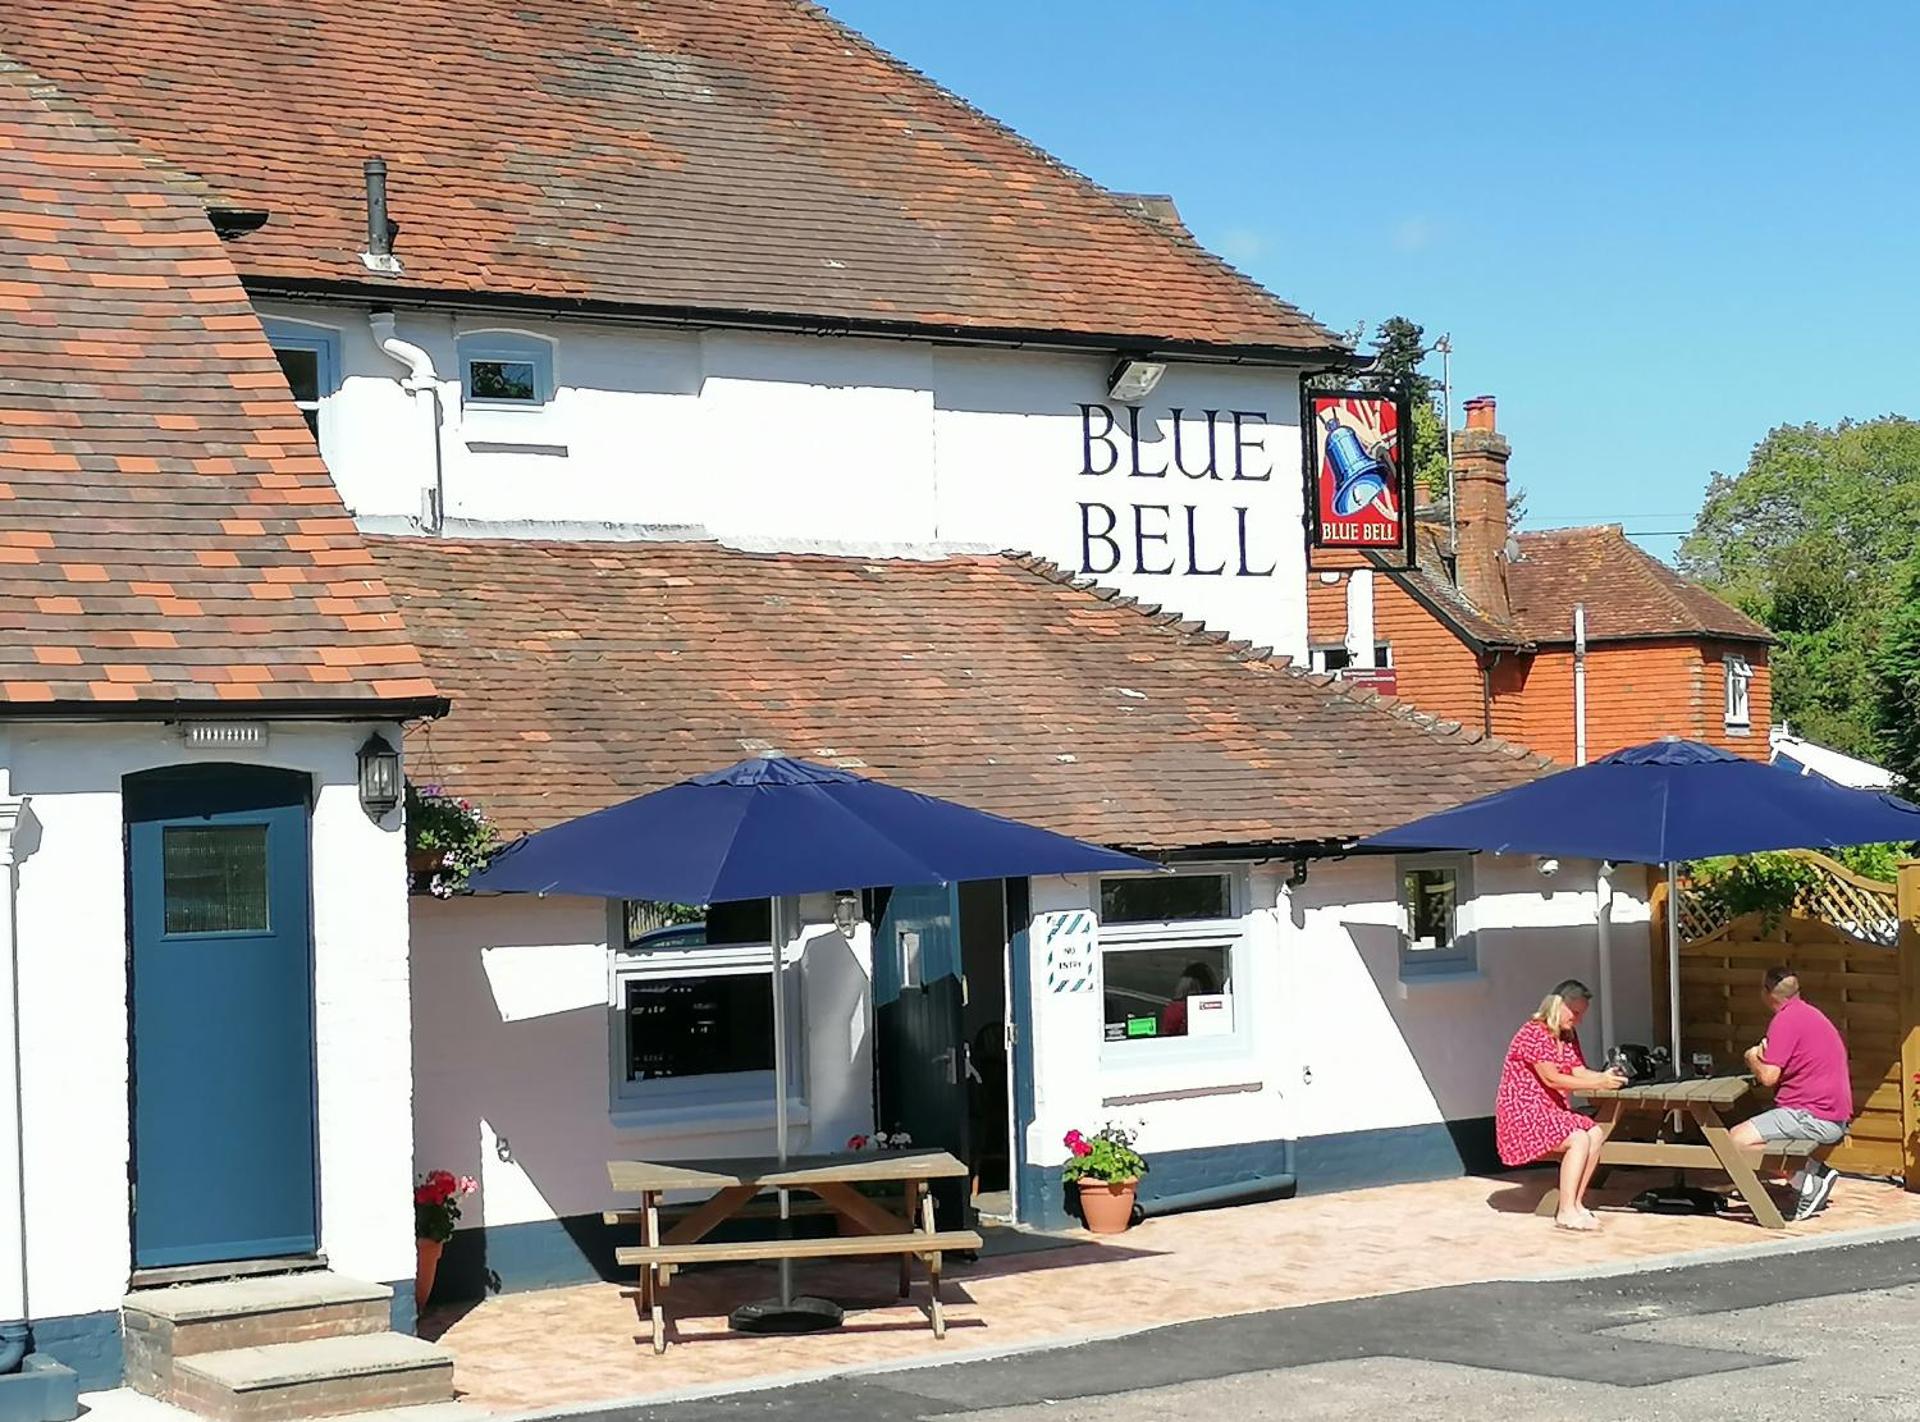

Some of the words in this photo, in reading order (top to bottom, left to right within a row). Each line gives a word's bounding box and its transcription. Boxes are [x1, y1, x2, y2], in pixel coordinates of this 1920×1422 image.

[1075, 402, 1273, 481] BLUE
[1075, 501, 1277, 577] BELL
[1322, 522, 1359, 541] BLUE
[1363, 522, 1395, 541] BELL
